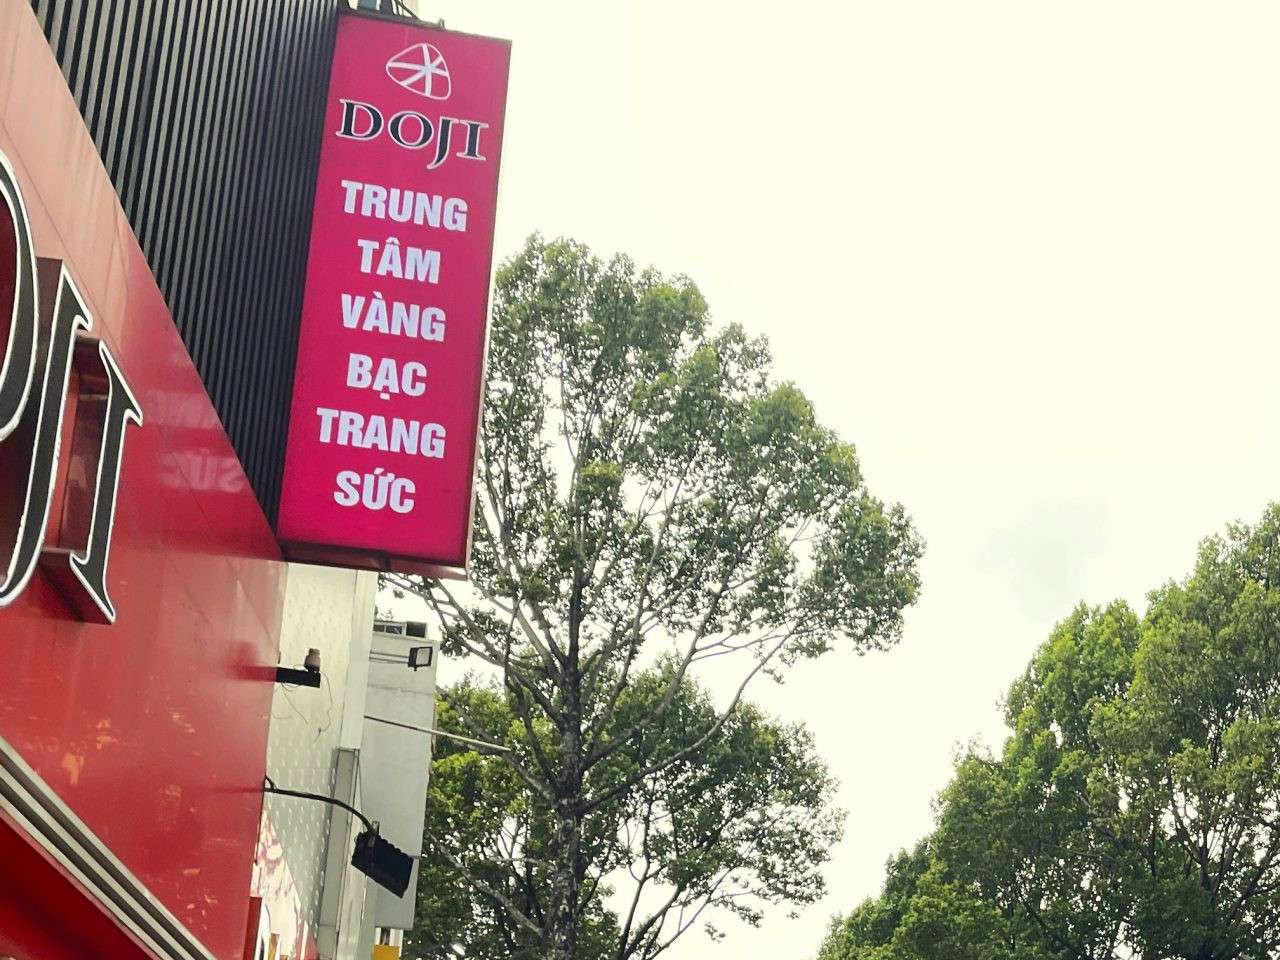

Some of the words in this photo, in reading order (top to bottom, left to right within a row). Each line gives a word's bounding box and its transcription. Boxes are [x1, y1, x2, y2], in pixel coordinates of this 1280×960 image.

[336, 99, 489, 169] DOJI
[341, 180, 468, 232] TRUNG
[357, 237, 441, 284] TÂM
[341, 291, 446, 342] VÀNG
[346, 353, 427, 400] BẠC
[316, 407, 446, 459] TRANG
[333, 467, 416, 514] SỨC
